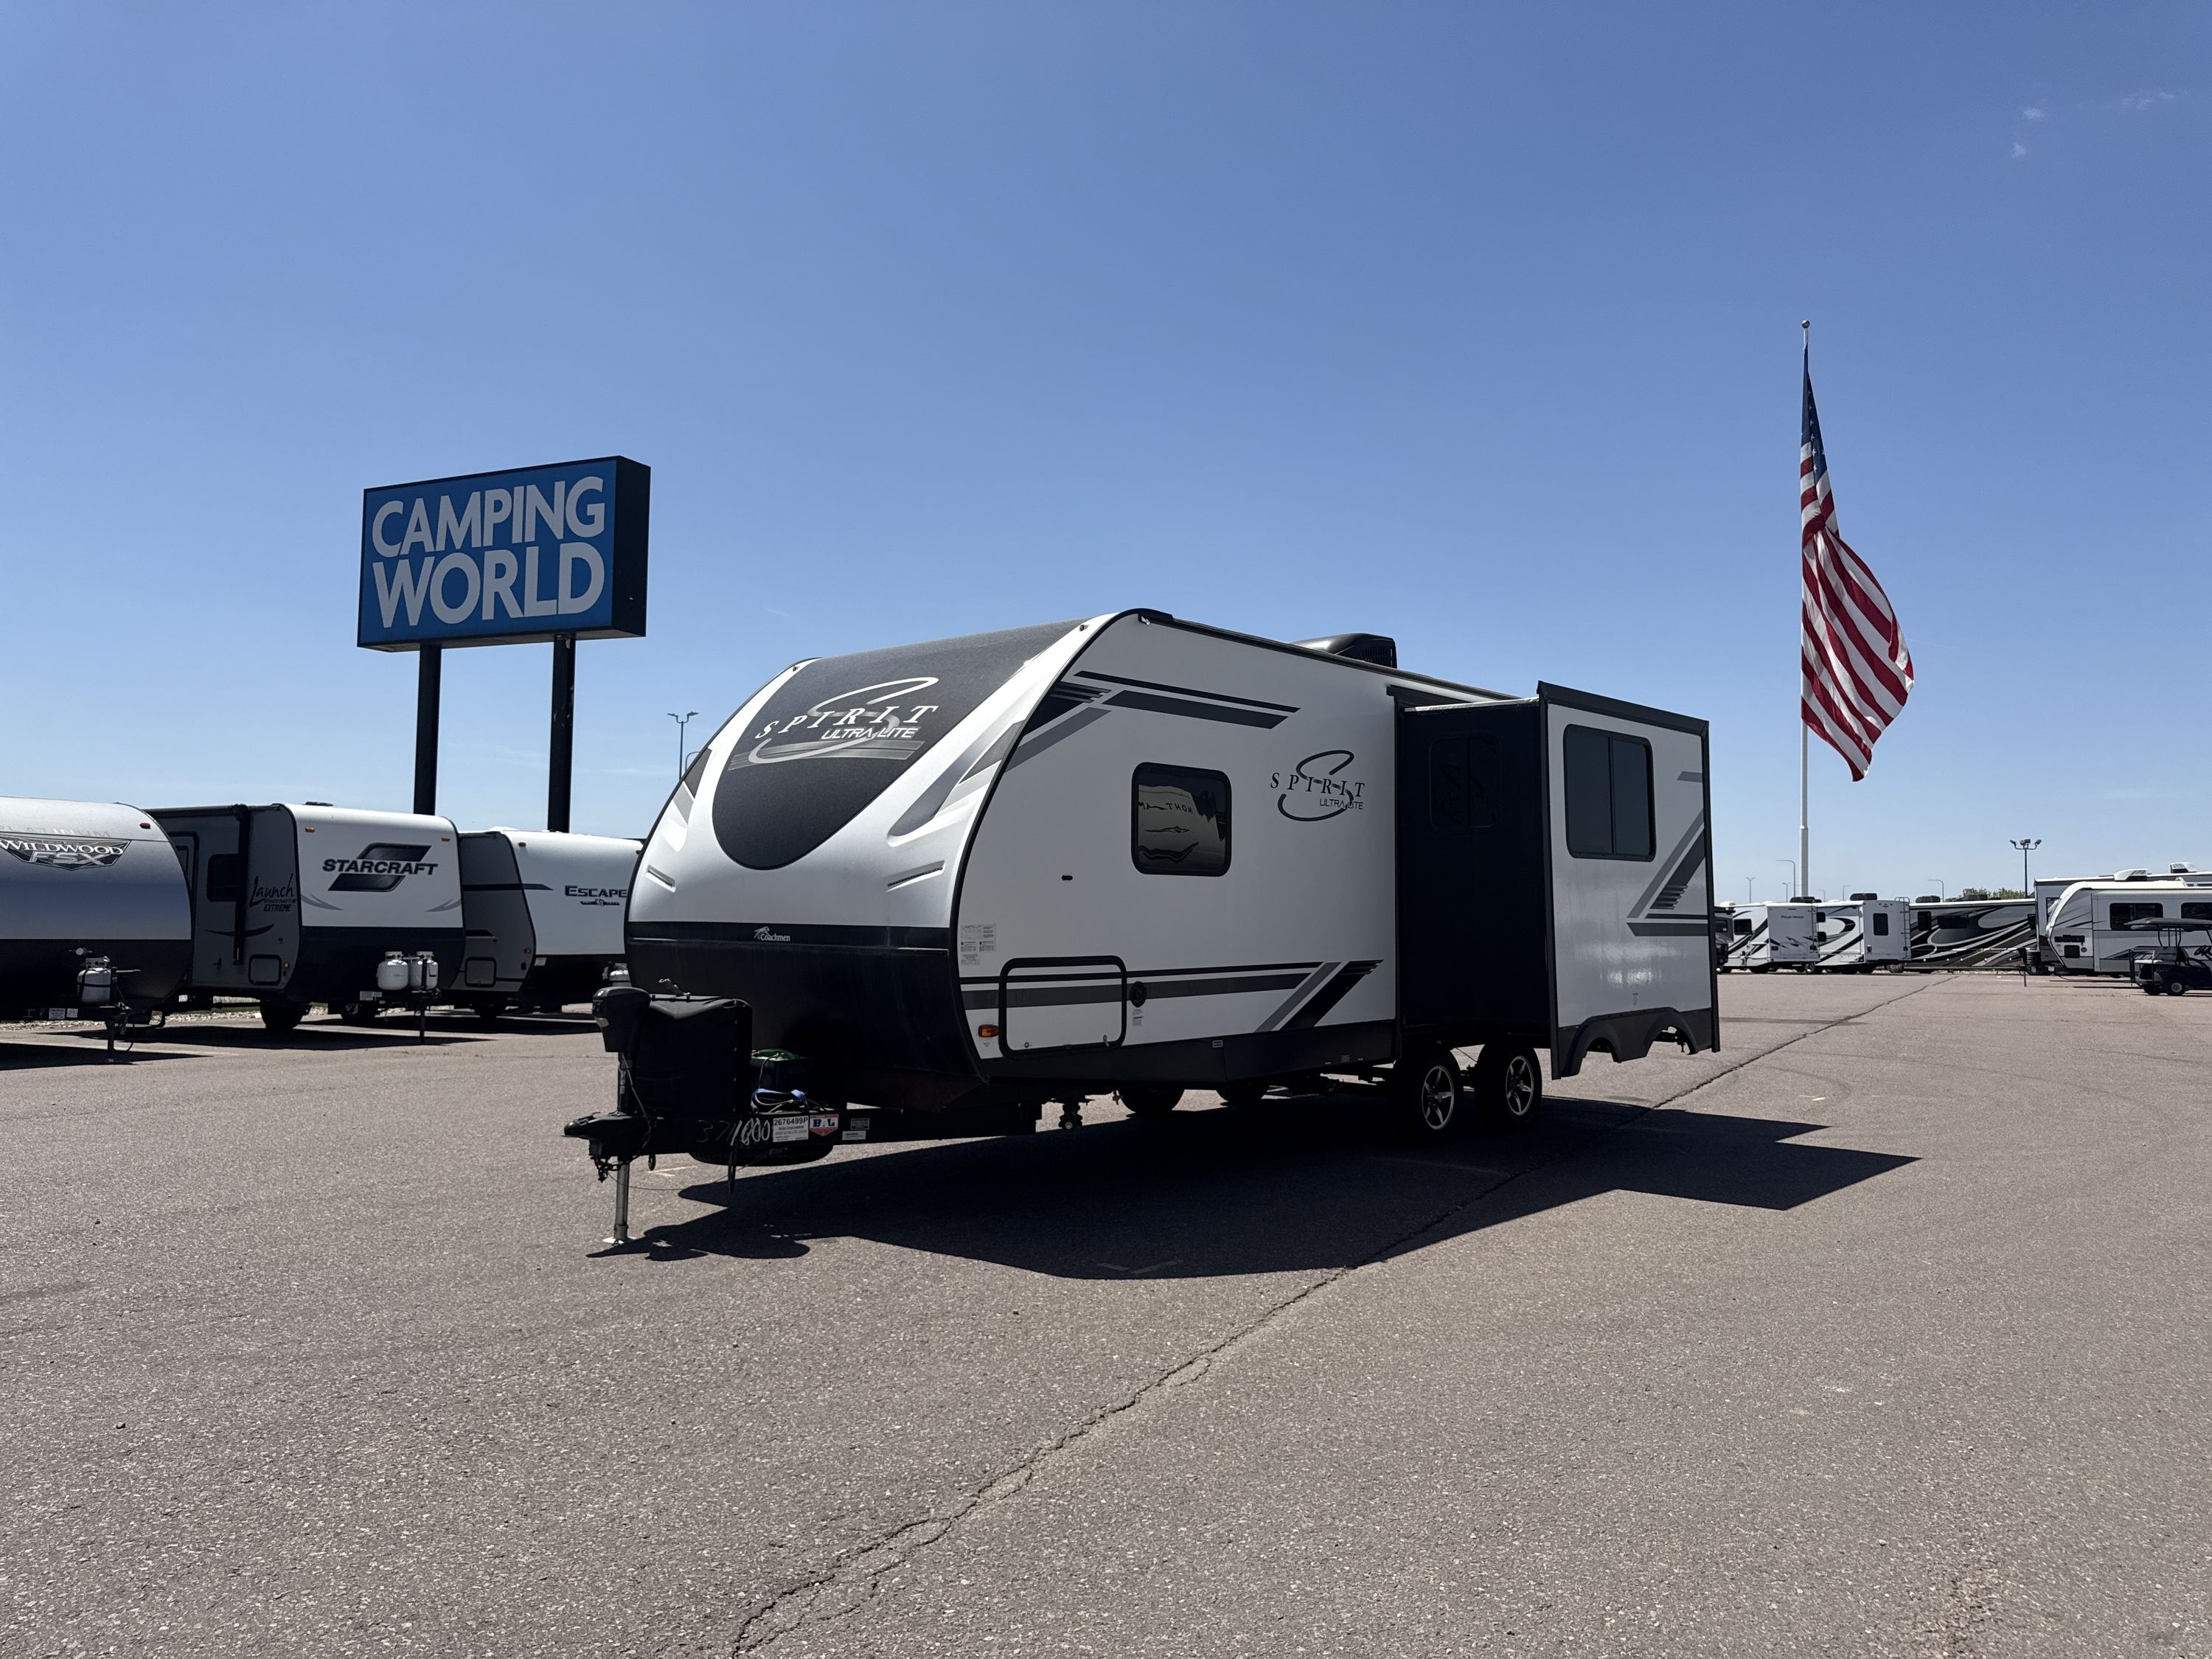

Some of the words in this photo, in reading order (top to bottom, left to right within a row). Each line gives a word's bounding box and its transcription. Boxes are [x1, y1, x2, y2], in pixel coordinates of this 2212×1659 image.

[372, 476, 605, 557] CAMPING
[372, 542, 605, 628] WORLD
[755, 705, 939, 739] SPIRIT
[821, 727, 872, 740] ULTRA
[876, 726, 919, 738] LITE
[1270, 772, 1366, 797] SPIRIT
[1320, 798, 1346, 808] ULTRA
[0, 840, 123, 855] WILDWOOD
[29, 851, 111, 866] FSX
[322, 858, 438, 875] STARCRAFT
[249, 873, 294, 908] Launch
[565, 886, 627, 898] ESCAPE
[263, 903, 292, 912] EXTREME
[760, 933, 790, 942] Coachmen
[773, 1117, 808, 1126] 2676499P
